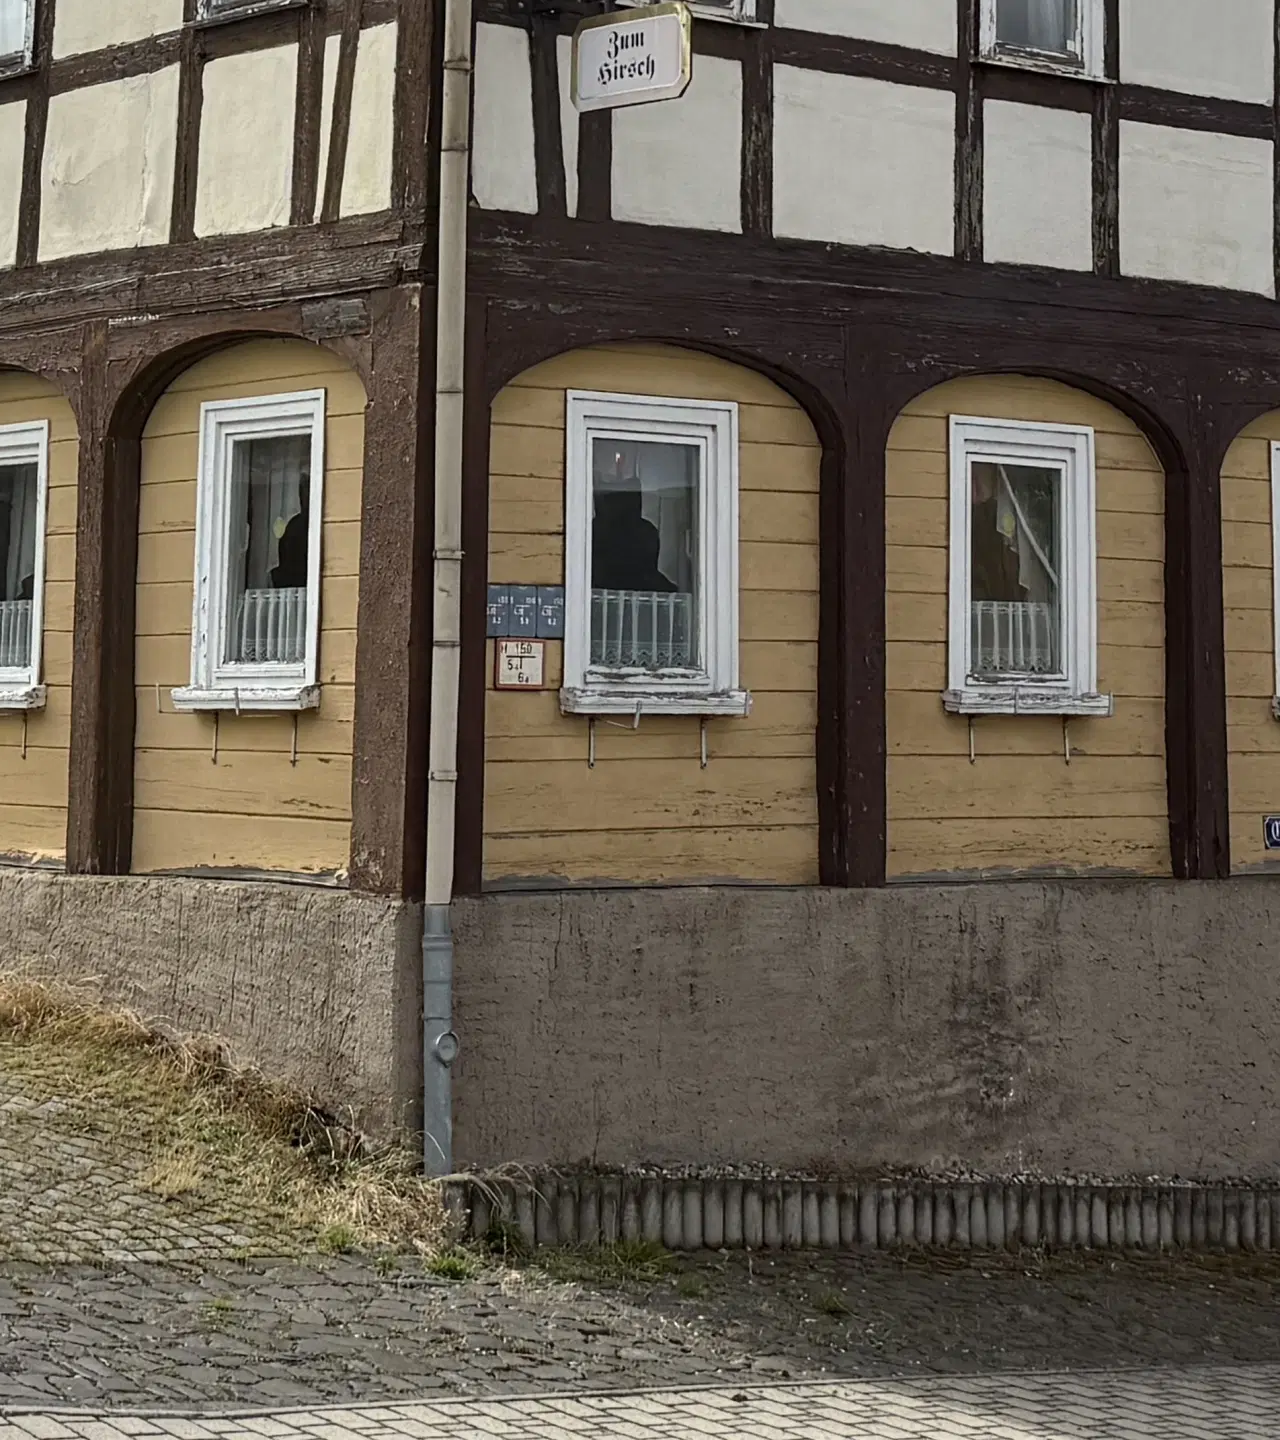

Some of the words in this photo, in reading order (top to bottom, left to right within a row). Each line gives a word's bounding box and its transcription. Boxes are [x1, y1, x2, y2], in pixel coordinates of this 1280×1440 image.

[607, 31, 644, 59] Zum
[597, 54, 655, 85] Hirsch
[516, 643, 532, 654] 150
